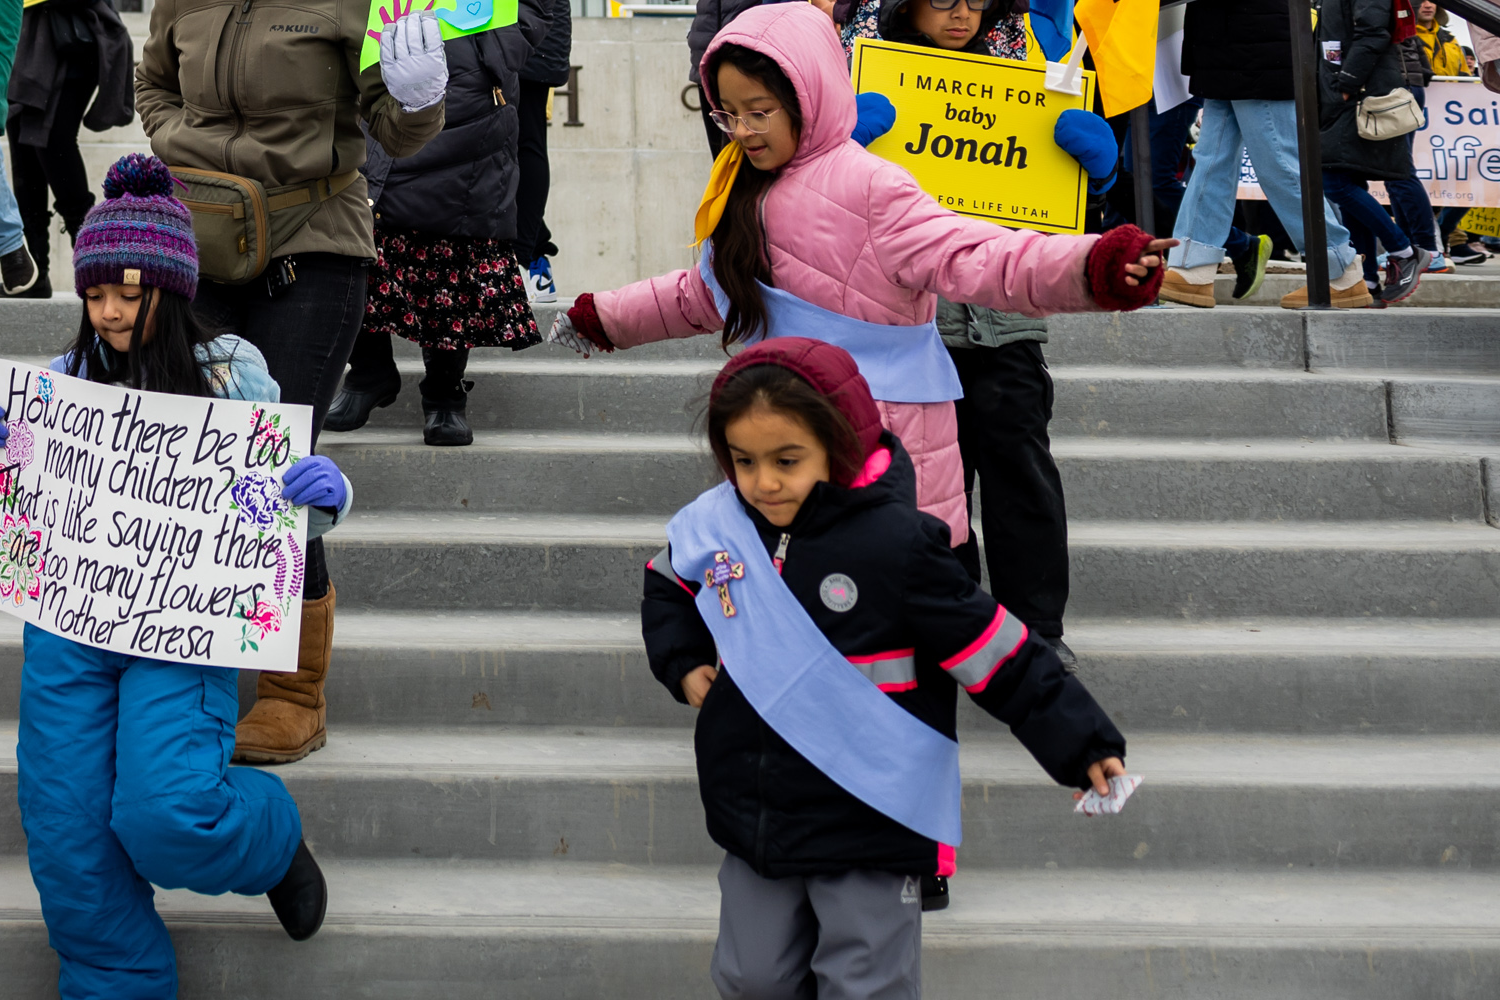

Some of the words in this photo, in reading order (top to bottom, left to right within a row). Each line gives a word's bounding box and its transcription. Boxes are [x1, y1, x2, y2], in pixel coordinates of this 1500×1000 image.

[285, 24, 319, 34] KUIU
[900, 72, 904, 86] I
[916, 75, 993, 99] MARCH
[1005, 88, 1046, 107] FOR
[945, 103, 996, 130] baby
[905, 123, 1028, 169] Jonah
[938, 195, 964, 207] FOR
[973, 200, 1003, 212] LIFE
[1011, 205, 1049, 219] UTAH
[5, 367, 63, 430] How
[62, 402, 103, 446] can
[112, 393, 188, 458] there
[193, 402, 236, 466] be
[245, 409, 290, 469] too
[45, 438, 104, 507] many
[108, 448, 234, 514] children?
[0, 464, 43, 517] That
[43, 491, 59, 529] is
[62, 490, 97, 544] like
[214, 514, 282, 569] there
[10, 534, 40, 568] are
[43, 530, 68, 581] too
[74, 554, 143, 619] many
[146, 556, 265, 619] flowers
[38, 580, 128, 645] Mother
[129, 608, 214, 660] Teresa
